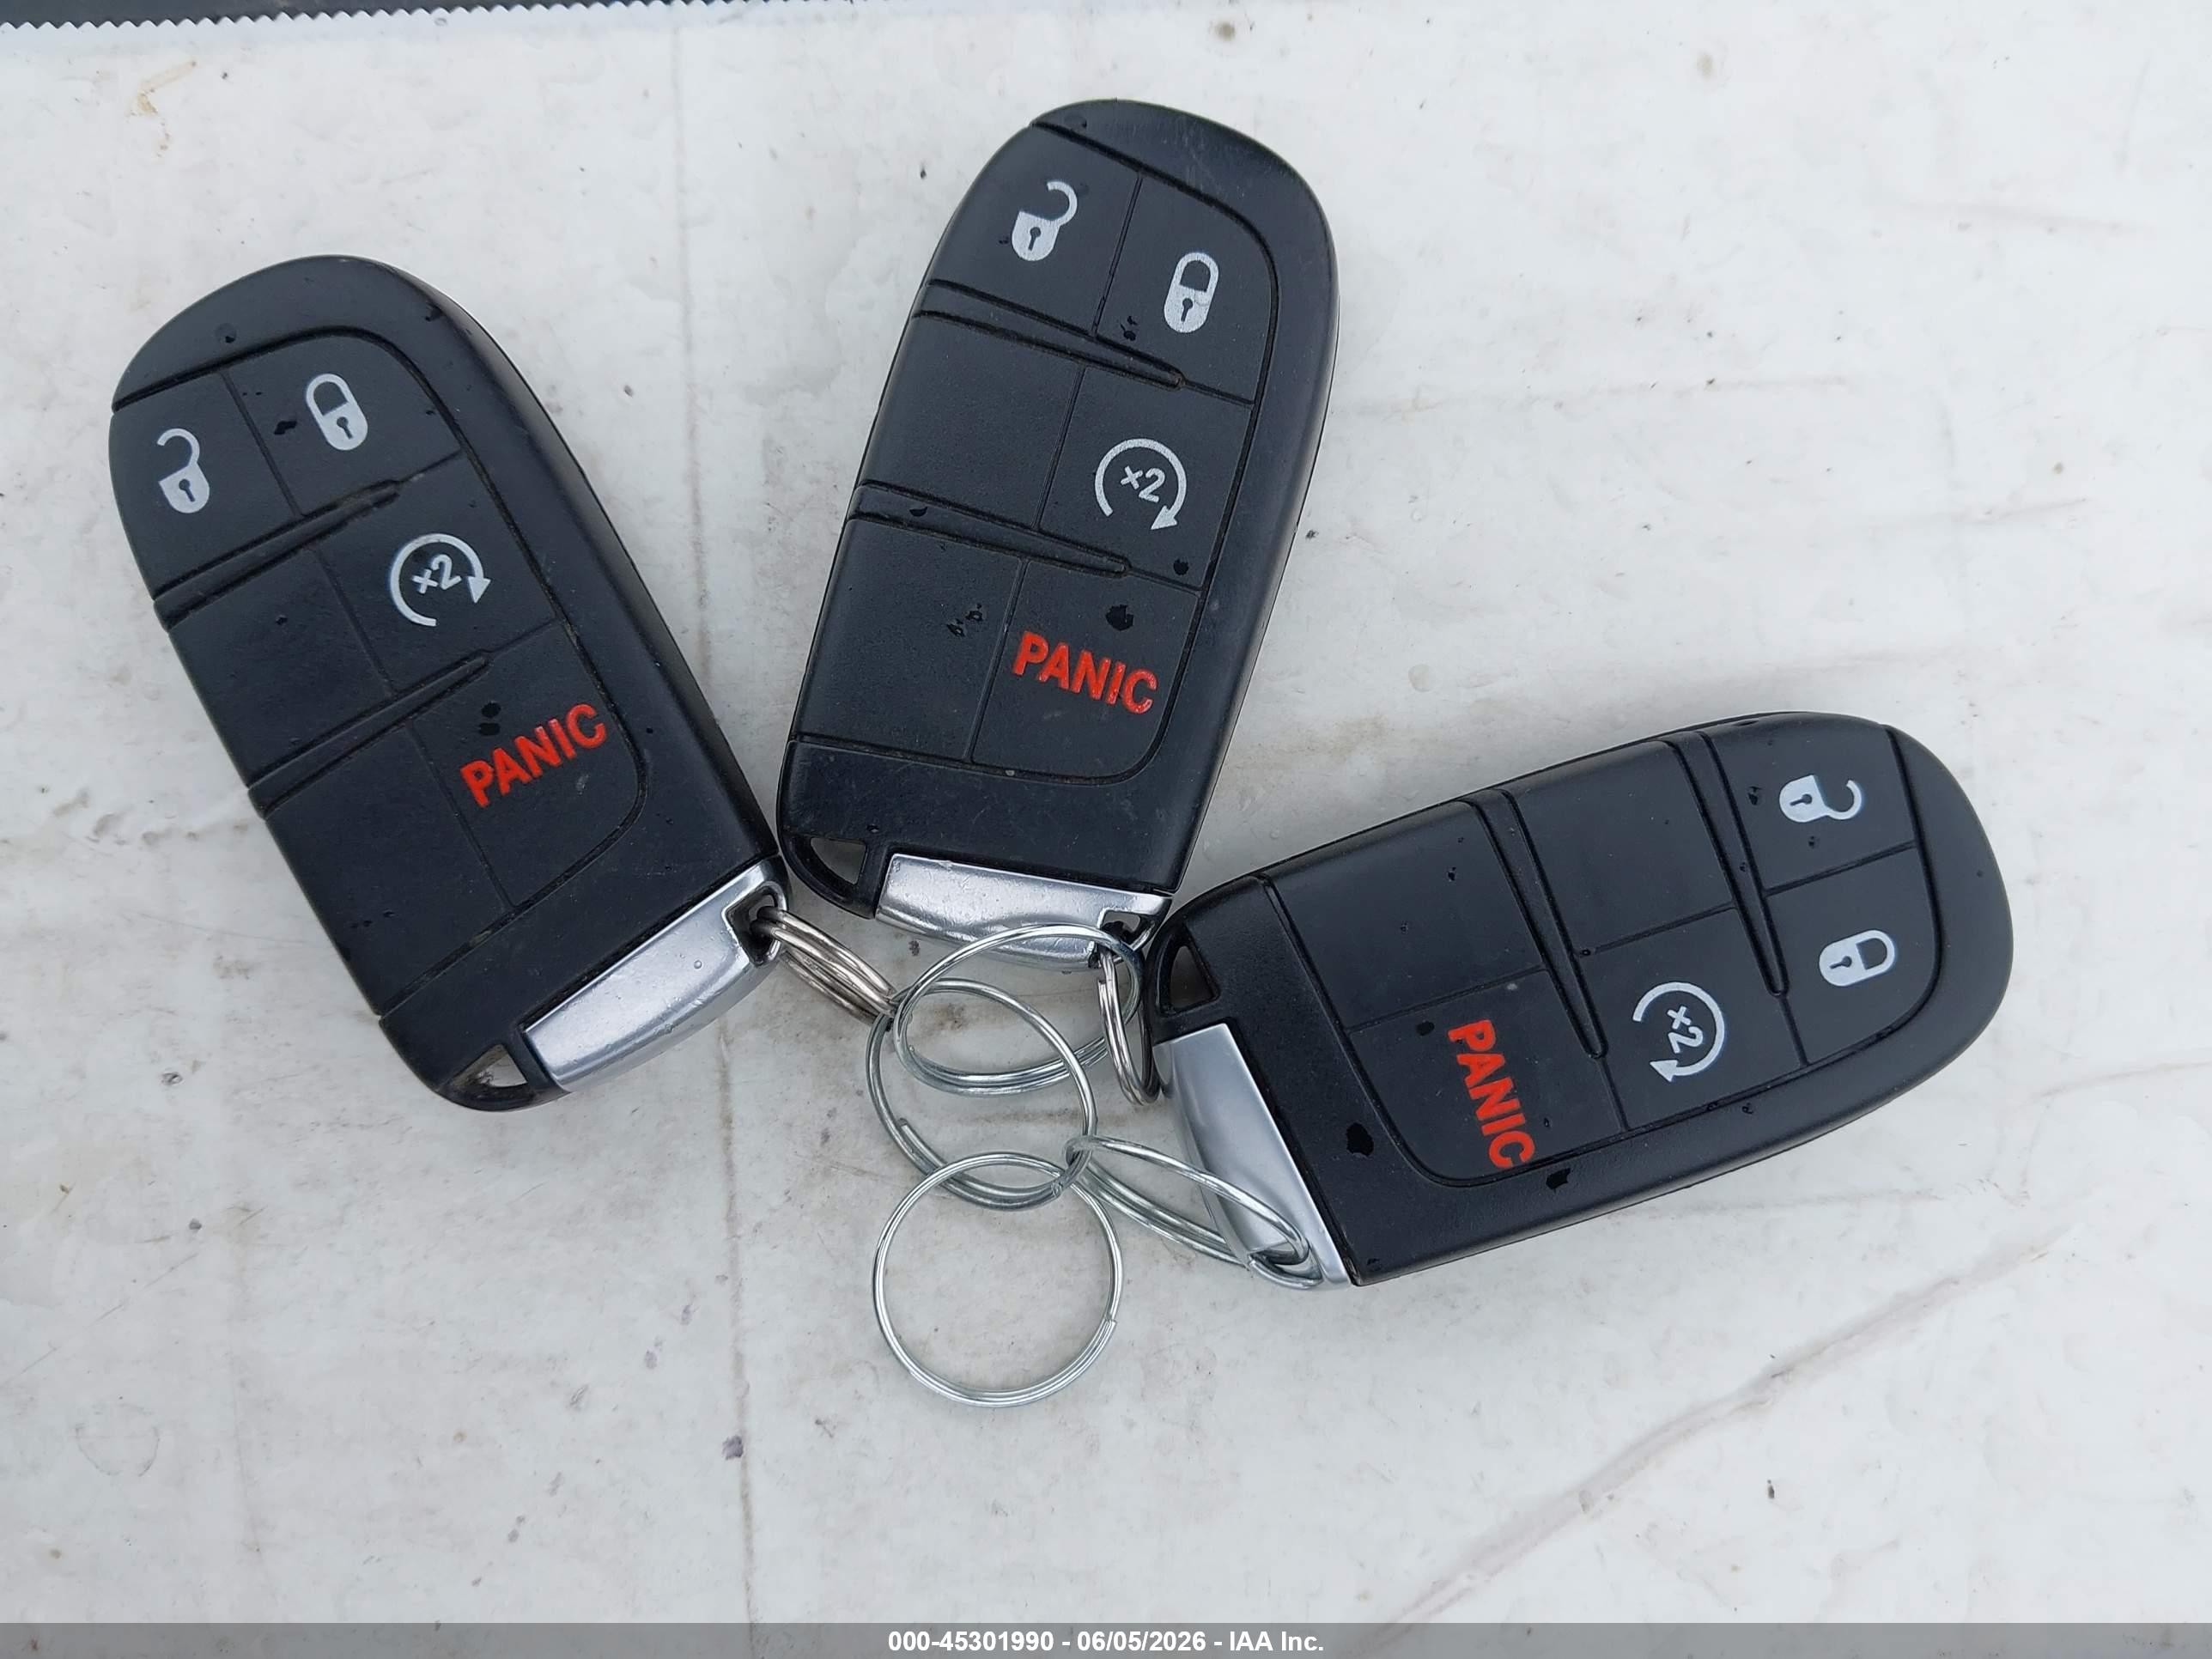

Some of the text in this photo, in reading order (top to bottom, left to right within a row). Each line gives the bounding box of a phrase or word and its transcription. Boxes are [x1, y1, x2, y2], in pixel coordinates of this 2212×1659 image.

[1013, 632, 1155, 714] PANIC
[460, 704, 606, 806] PANIC
[1448, 1019, 1534, 1168] PANIC
